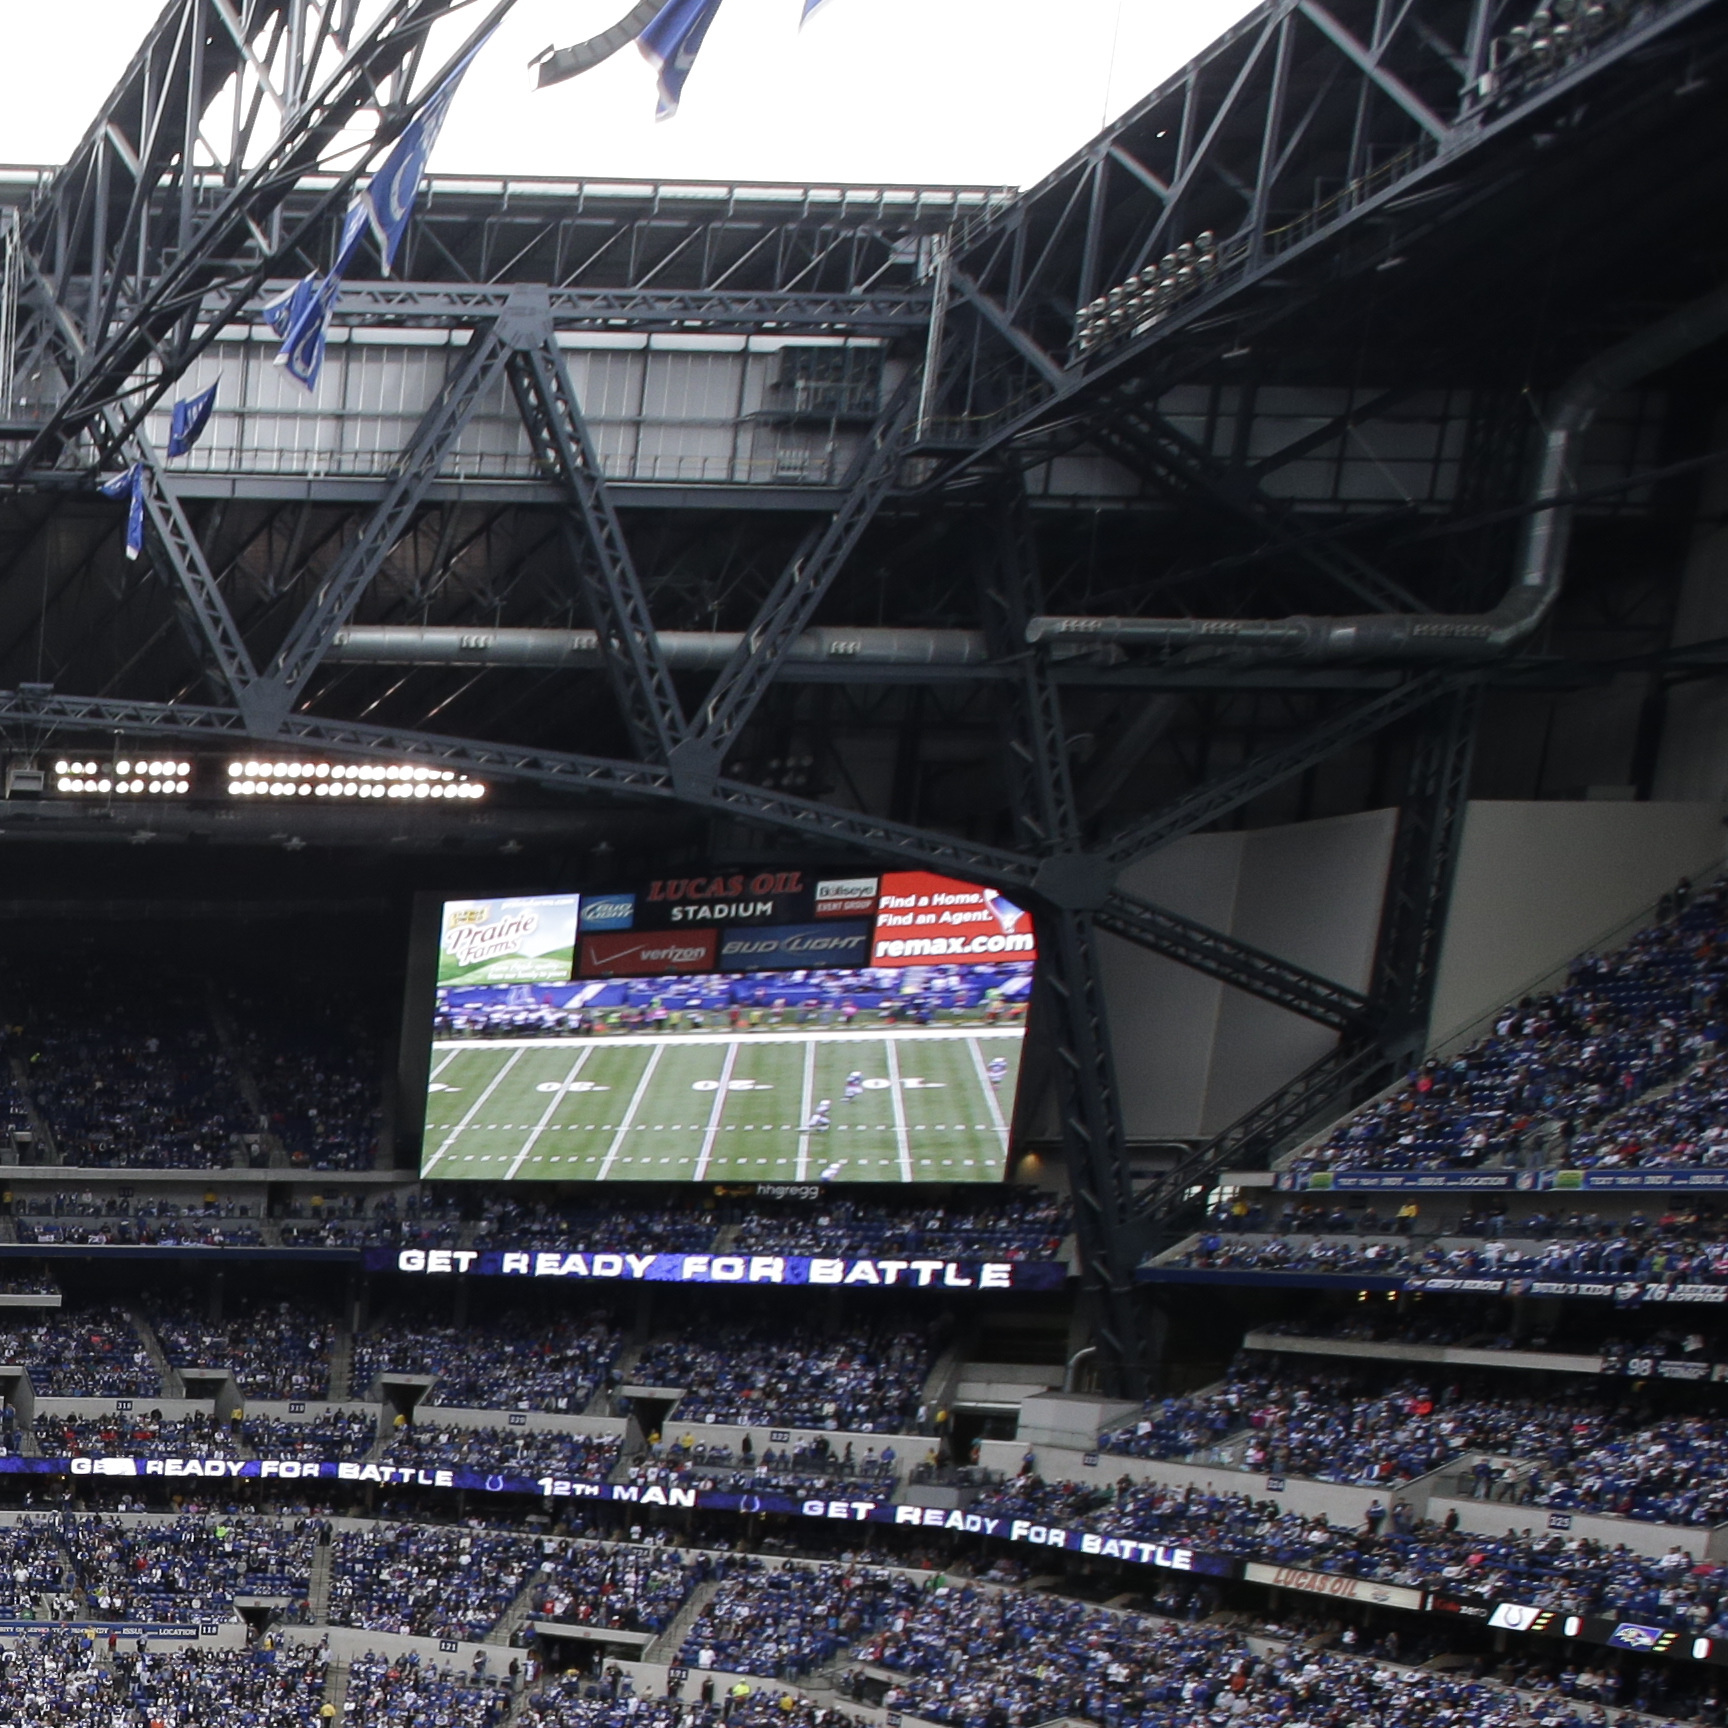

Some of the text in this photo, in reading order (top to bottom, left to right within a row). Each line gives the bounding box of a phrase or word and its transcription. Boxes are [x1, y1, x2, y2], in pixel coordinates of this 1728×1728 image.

[649, 871, 804, 900] LUCAS OIL
[671, 901, 773, 921] STADIUM
[878, 895, 915, 909] Find
[448, 913, 535, 946] Prairie
[876, 913, 913, 927] Find
[640, 946, 706, 962] verizon
[721, 939, 779, 955] BUD
[875, 933, 1034, 958] remax.com
[399, 1249, 1011, 1288] GET READY FOR BATTLE
[1627, 1358, 1653, 1376] 98
[147, 1459, 453, 1486] READY FOR BATTLE
[537, 1478, 695, 1506] 12TH MAN
[803, 1501, 1195, 1570] GET READY FOR BATTLE
[1273, 1568, 1358, 1598] LUCAS OIL
[159, 1627, 198, 1637] LOCATION
[441, 1641, 457, 1651] 121
